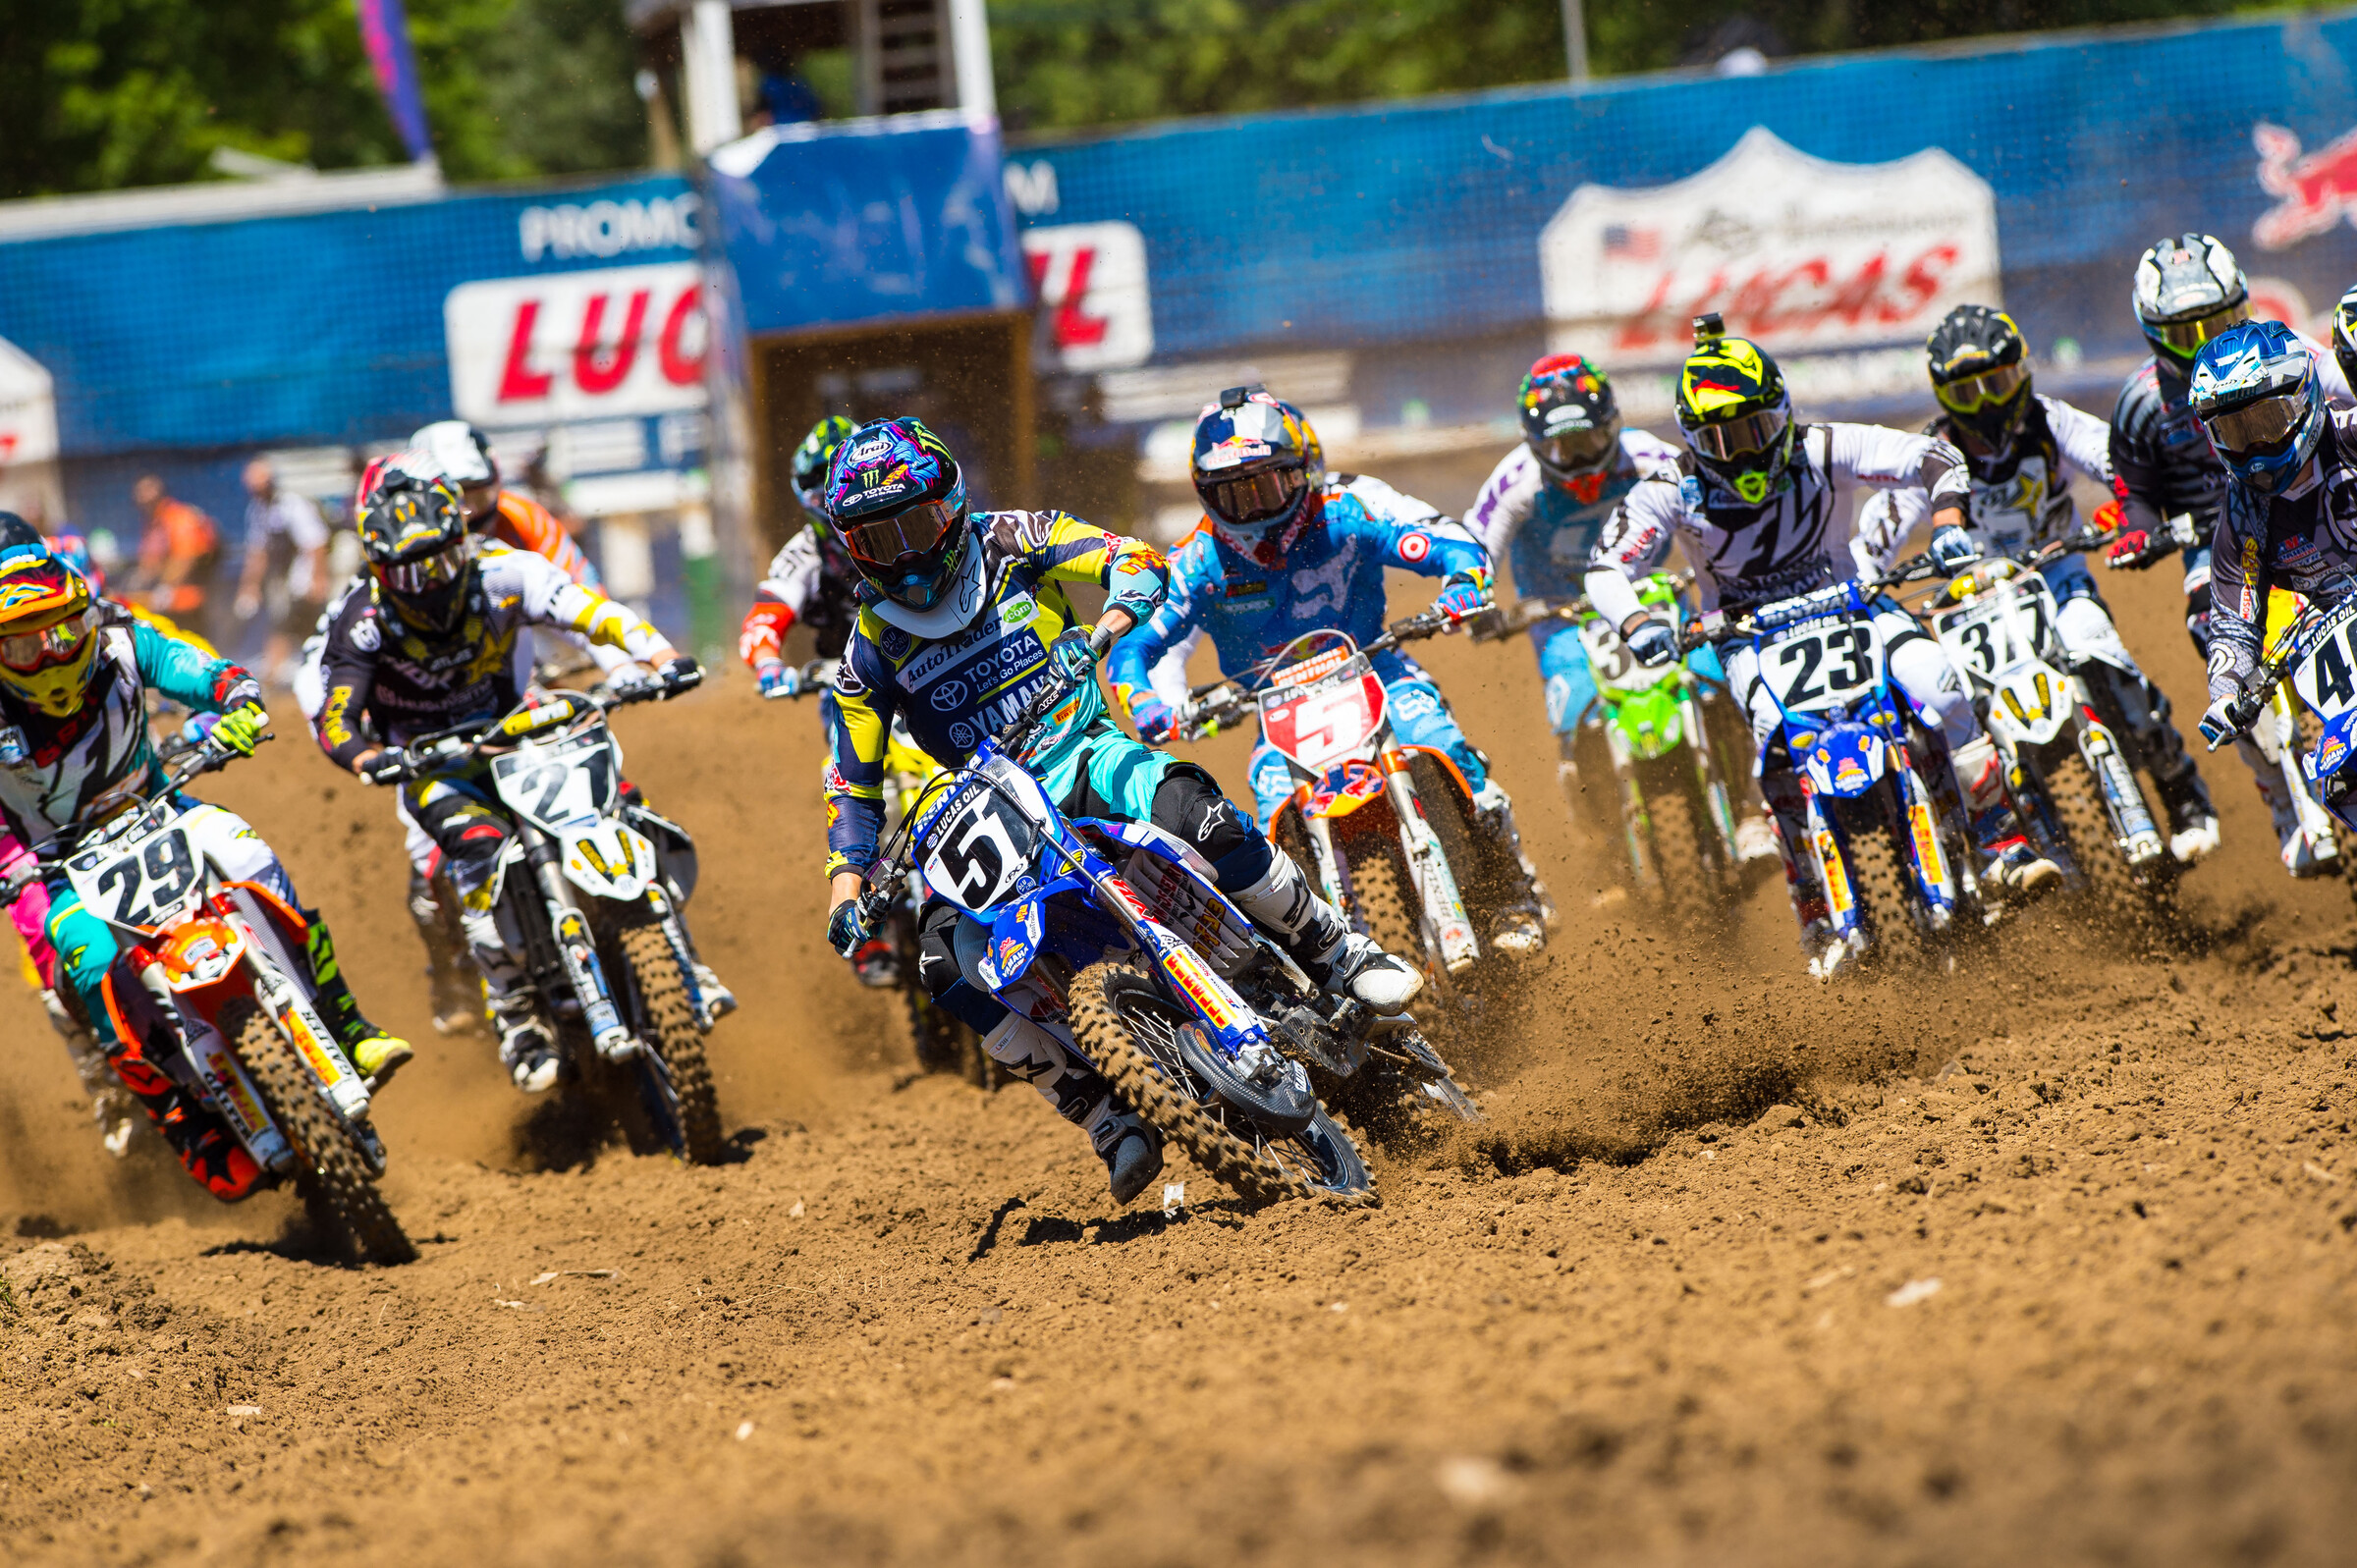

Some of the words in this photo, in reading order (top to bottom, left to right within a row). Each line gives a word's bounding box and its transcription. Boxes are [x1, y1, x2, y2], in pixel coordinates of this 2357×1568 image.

[1616, 243, 1960, 351] LUCAS
[858, 442, 885, 457] Arai
[862, 483, 906, 496] TOYOTA
[1004, 603, 1031, 622] .com
[1787, 618, 1821, 639] LUCAS
[1822, 615, 1840, 628] OIL
[2311, 616, 2337, 647] LUCAS
[2338, 605, 2356, 622] OIL
[963, 634, 1039, 684] TOYOTA
[976, 675, 1000, 693] Let's
[1000, 665, 1014, 679] Go
[1014, 650, 1044, 671] Places
[1780, 626, 1874, 709] 23
[968, 674, 1047, 737] YAMAH
[1037, 690, 1060, 715] ARC
[1295, 681, 1363, 763] 5
[521, 747, 611, 825] 21
[936, 800, 963, 837] LUCAS
[962, 784, 981, 804] OIL
[937, 780, 1032, 910] 51
[97, 828, 196, 928] 29
[1001, 946, 1030, 978] YAMAHA
[1163, 951, 1228, 1028] PIRELLI
